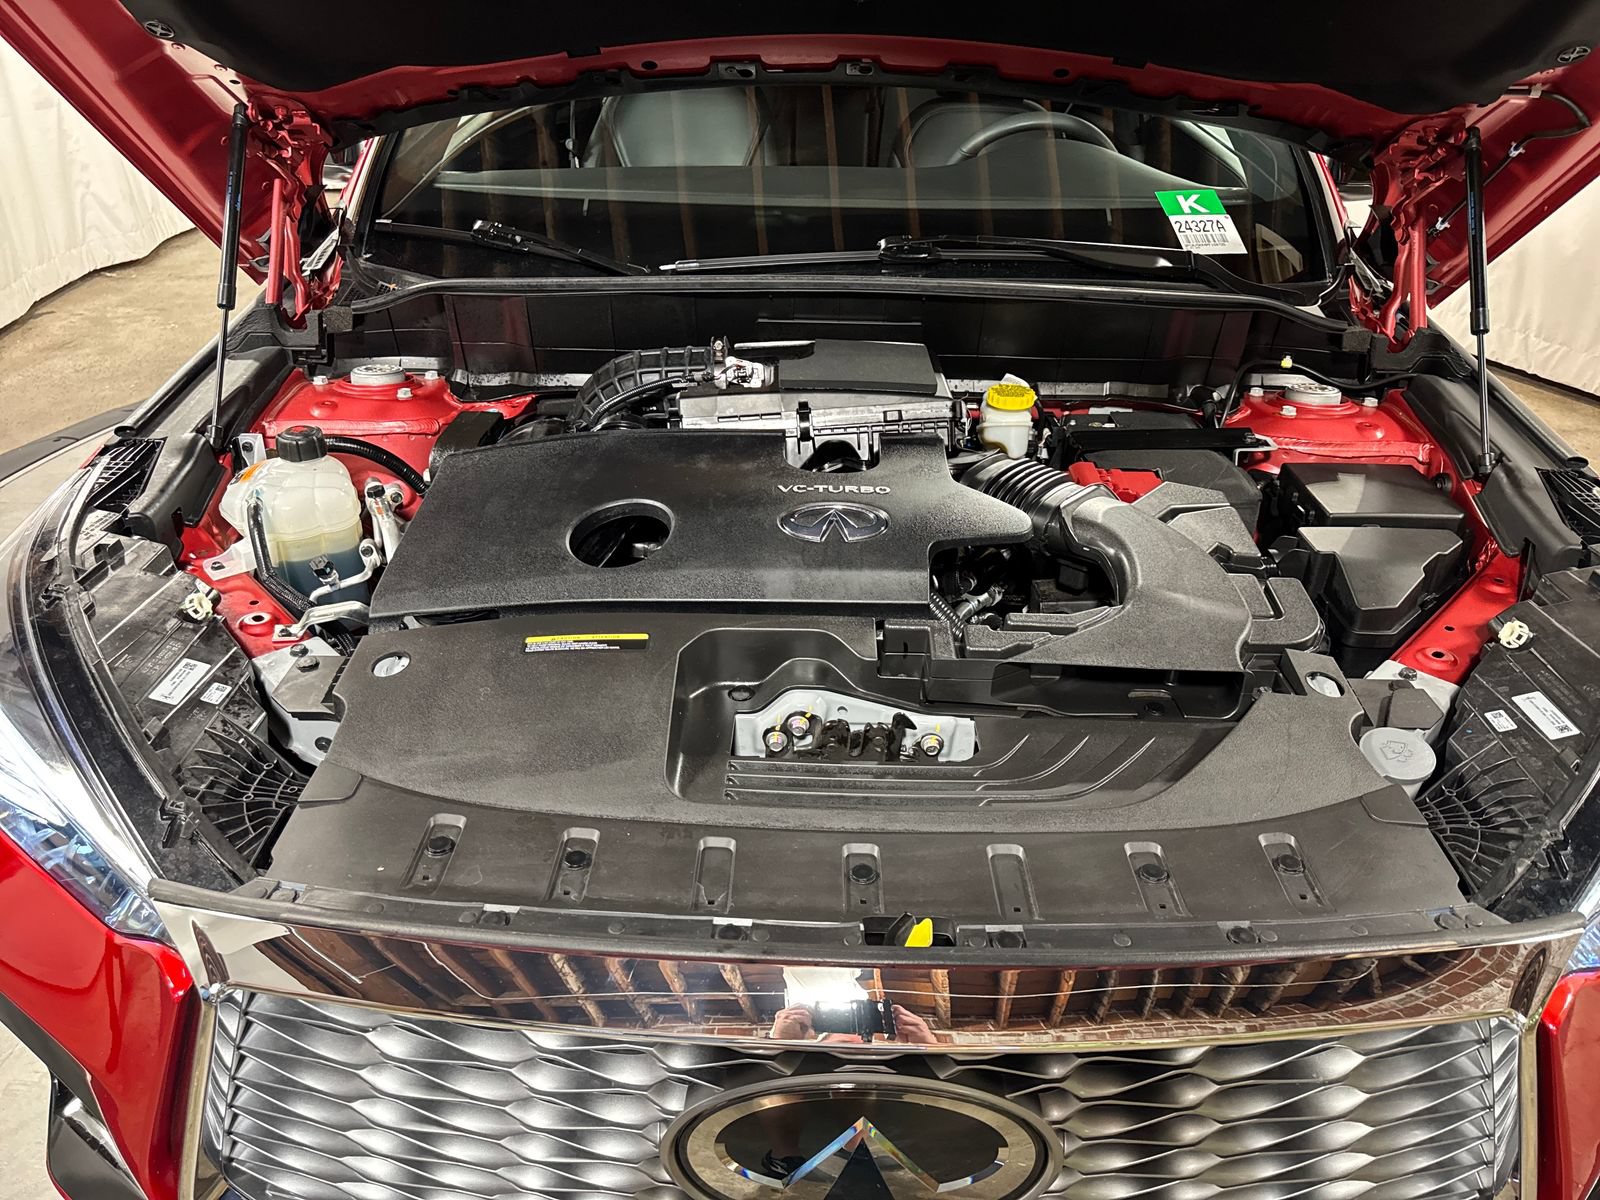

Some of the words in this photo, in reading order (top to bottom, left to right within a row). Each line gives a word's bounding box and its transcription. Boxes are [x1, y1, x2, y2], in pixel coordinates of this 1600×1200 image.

[1176, 194, 1211, 214] K
[1174, 220, 1227, 234] 24327A
[777, 484, 892, 494] VC-TURBO
